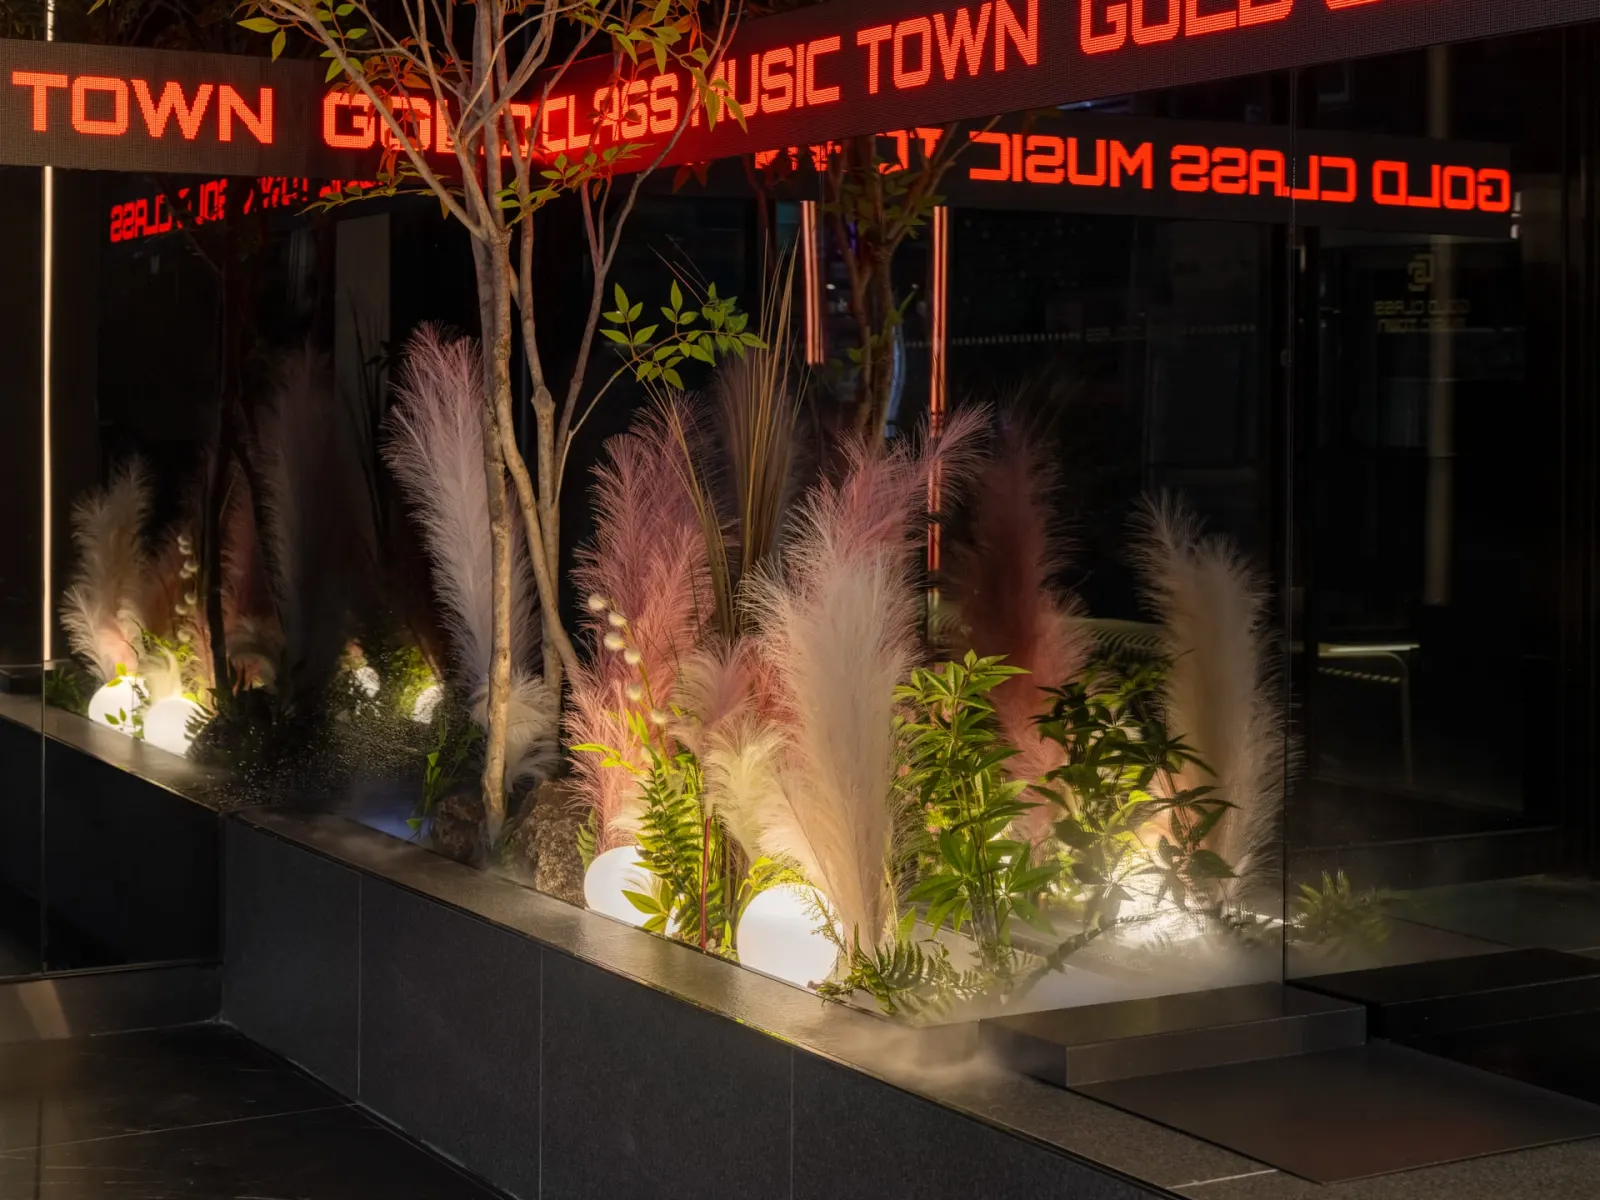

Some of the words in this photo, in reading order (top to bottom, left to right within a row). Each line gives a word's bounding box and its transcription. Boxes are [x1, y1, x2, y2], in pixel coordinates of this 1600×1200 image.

[12, 71, 274, 144] TOWN
[541, 72, 679, 154] CLASS
[856, 0, 1039, 94] TOWN
